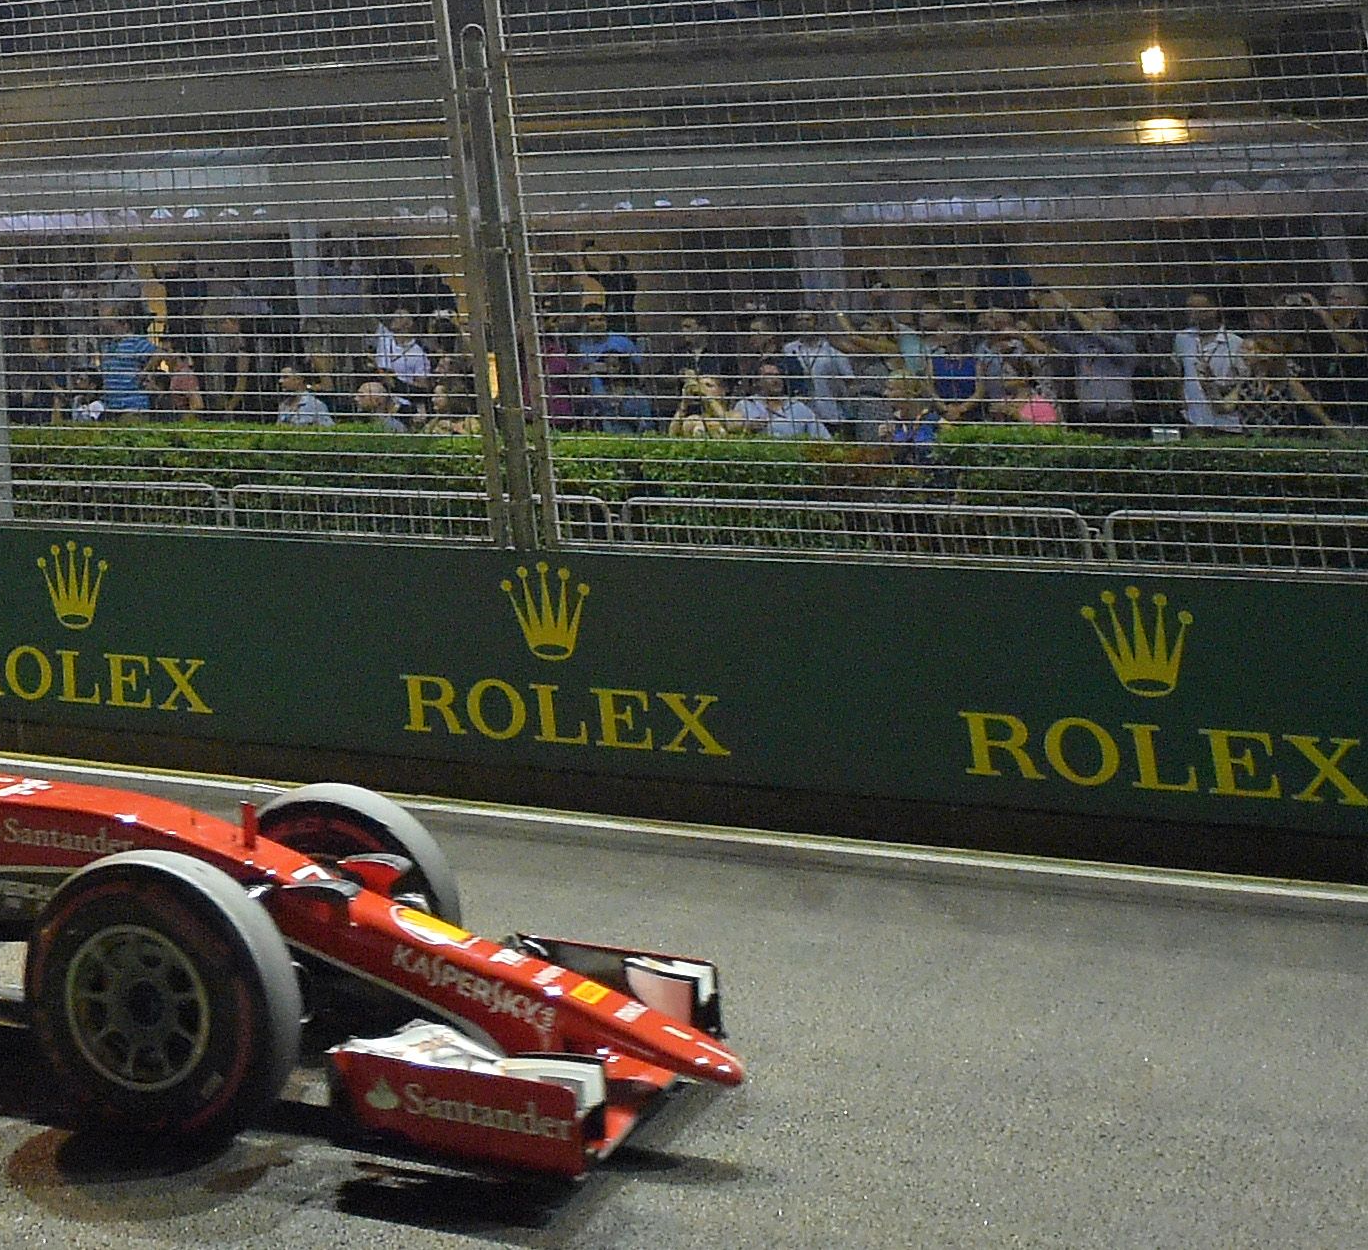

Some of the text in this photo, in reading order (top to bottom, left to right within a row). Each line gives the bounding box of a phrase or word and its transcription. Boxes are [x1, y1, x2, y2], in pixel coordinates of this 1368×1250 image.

[399, 674, 732, 757] ROLEX
[958, 711, 1368, 807] ROLEX
[3, 817, 135, 854] Santander
[402, 1082, 574, 1139] Santander
